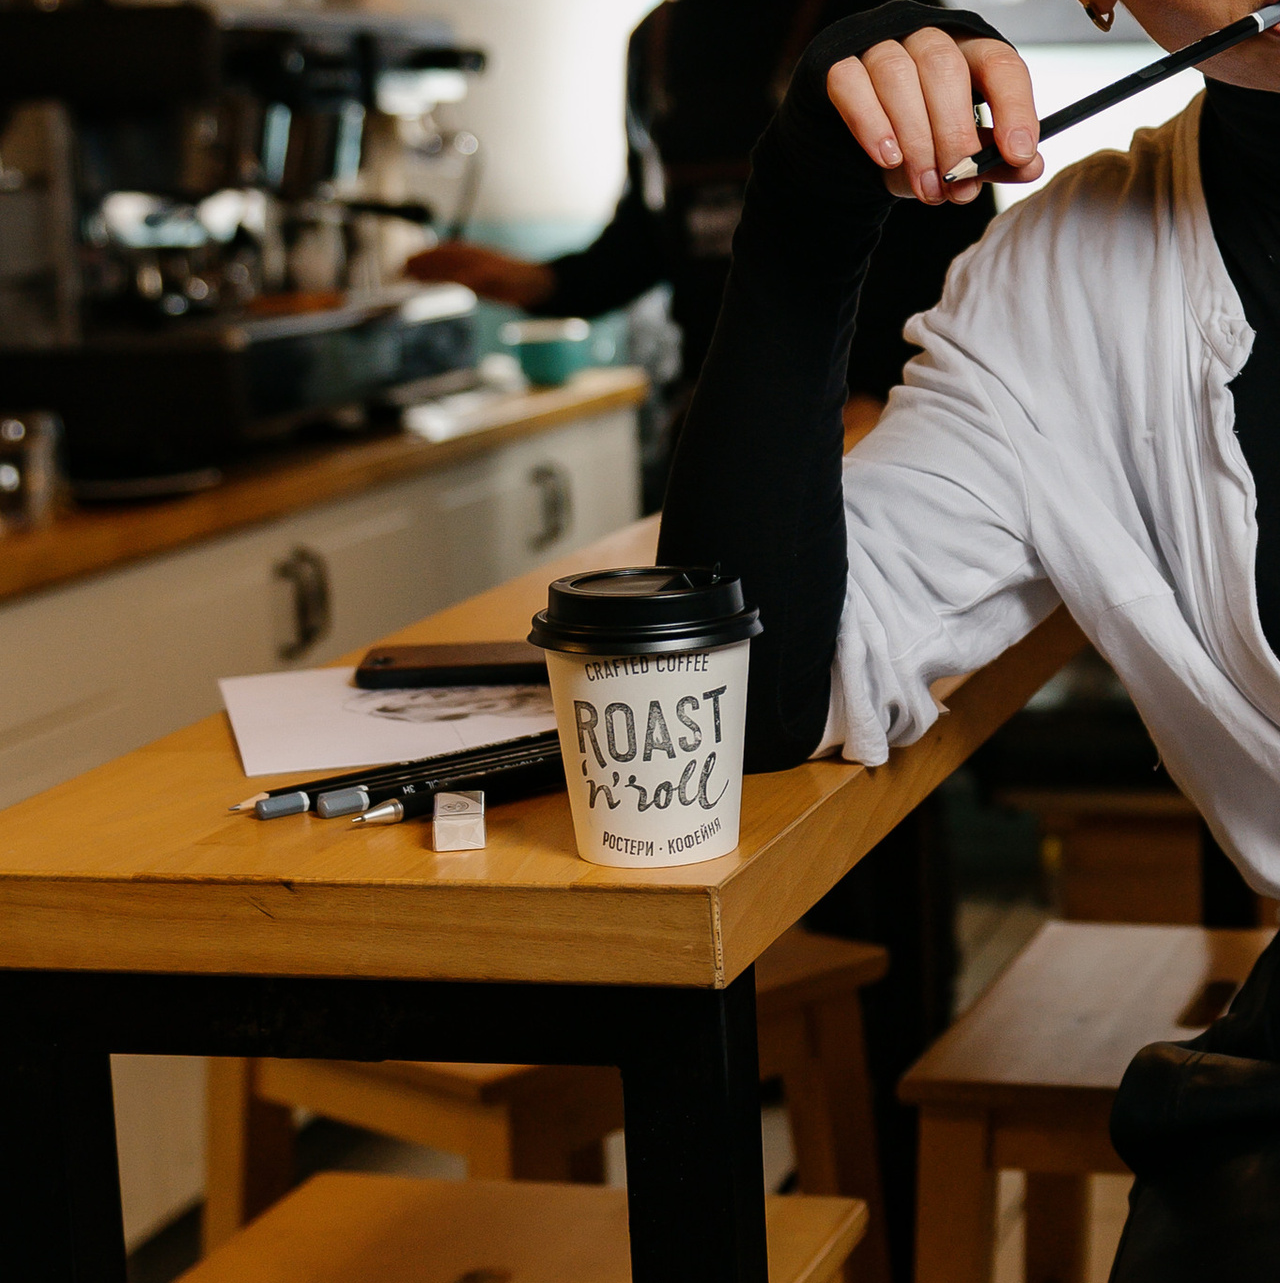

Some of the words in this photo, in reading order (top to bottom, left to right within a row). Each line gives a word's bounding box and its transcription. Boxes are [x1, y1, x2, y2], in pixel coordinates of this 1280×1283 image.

[585, 656, 649, 681] CRAFTED
[656, 653, 710, 672] COFFEE
[573, 685, 727, 769] ROAST
[602, 831, 654, 857] РОСТЕРИ
[667, 817, 721, 855] КОФЕЙНЯ
